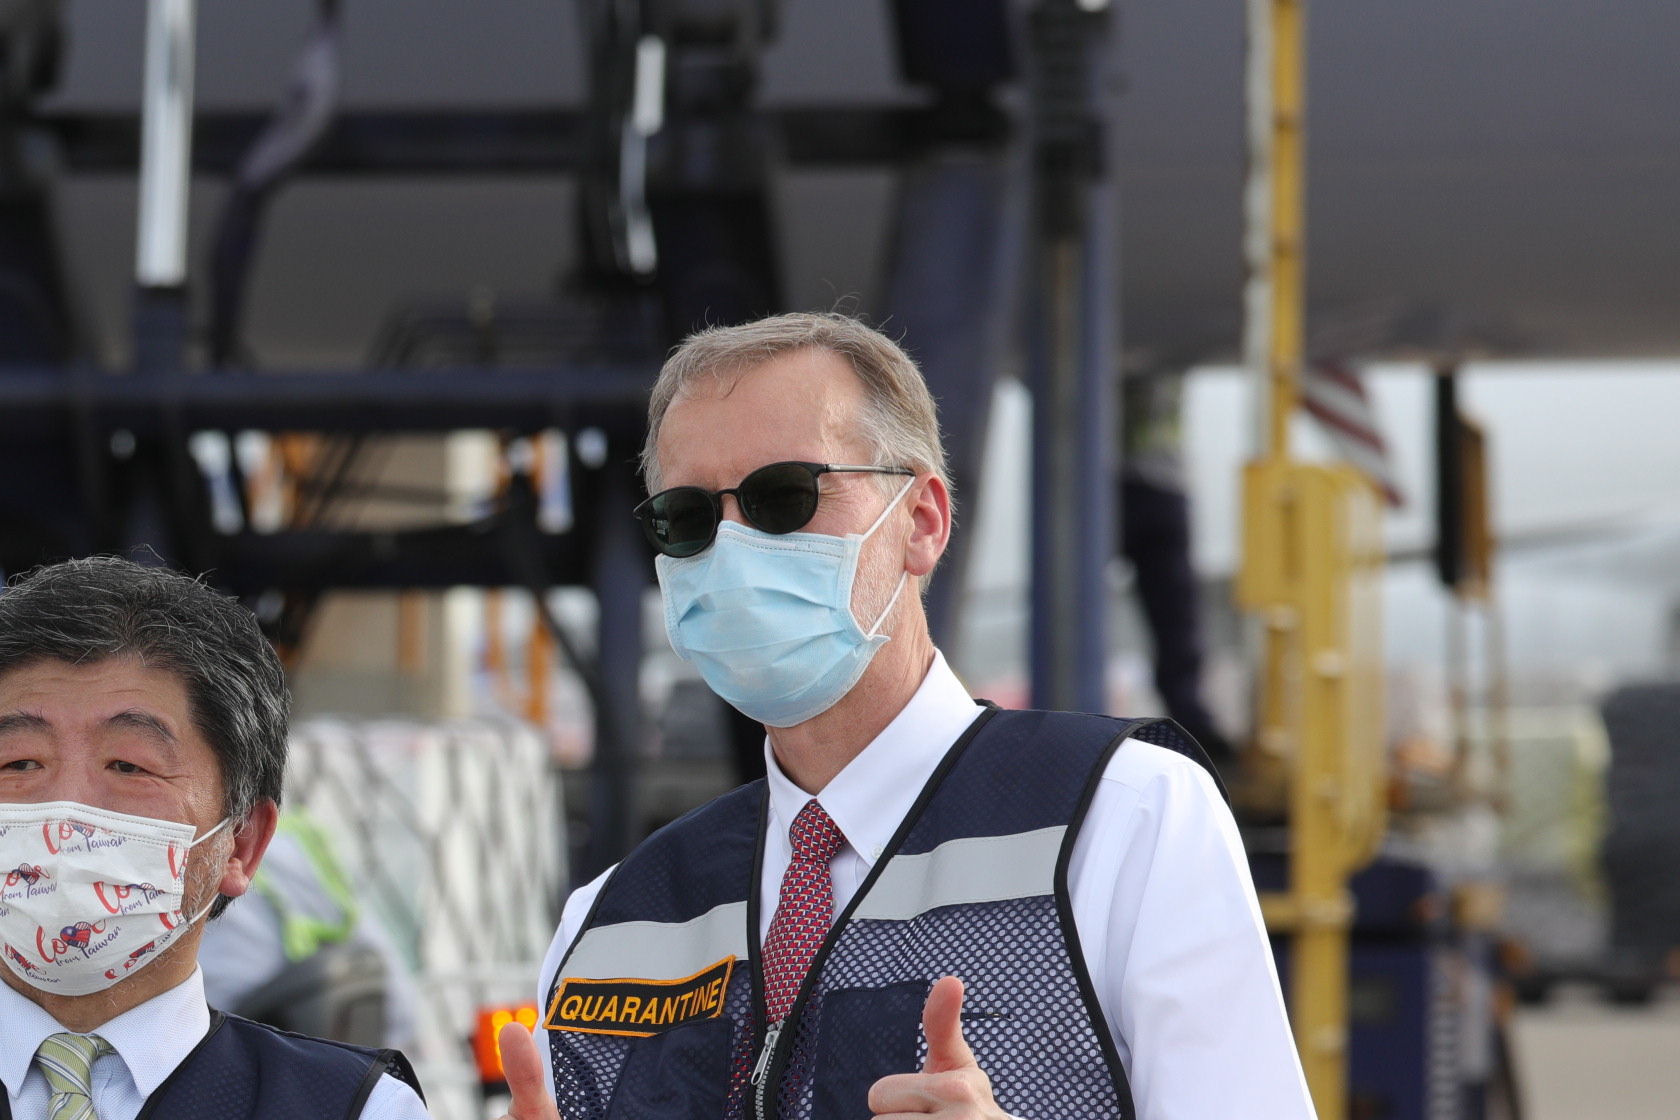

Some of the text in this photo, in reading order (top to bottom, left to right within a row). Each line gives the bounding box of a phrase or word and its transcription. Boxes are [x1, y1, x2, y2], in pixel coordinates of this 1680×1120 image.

[83, 835, 127, 852] Taiwan
[23, 881, 57, 899] Taiwa
[80, 926, 121, 959] Taiwan
[560, 977, 722, 1025] QUARANTINE
